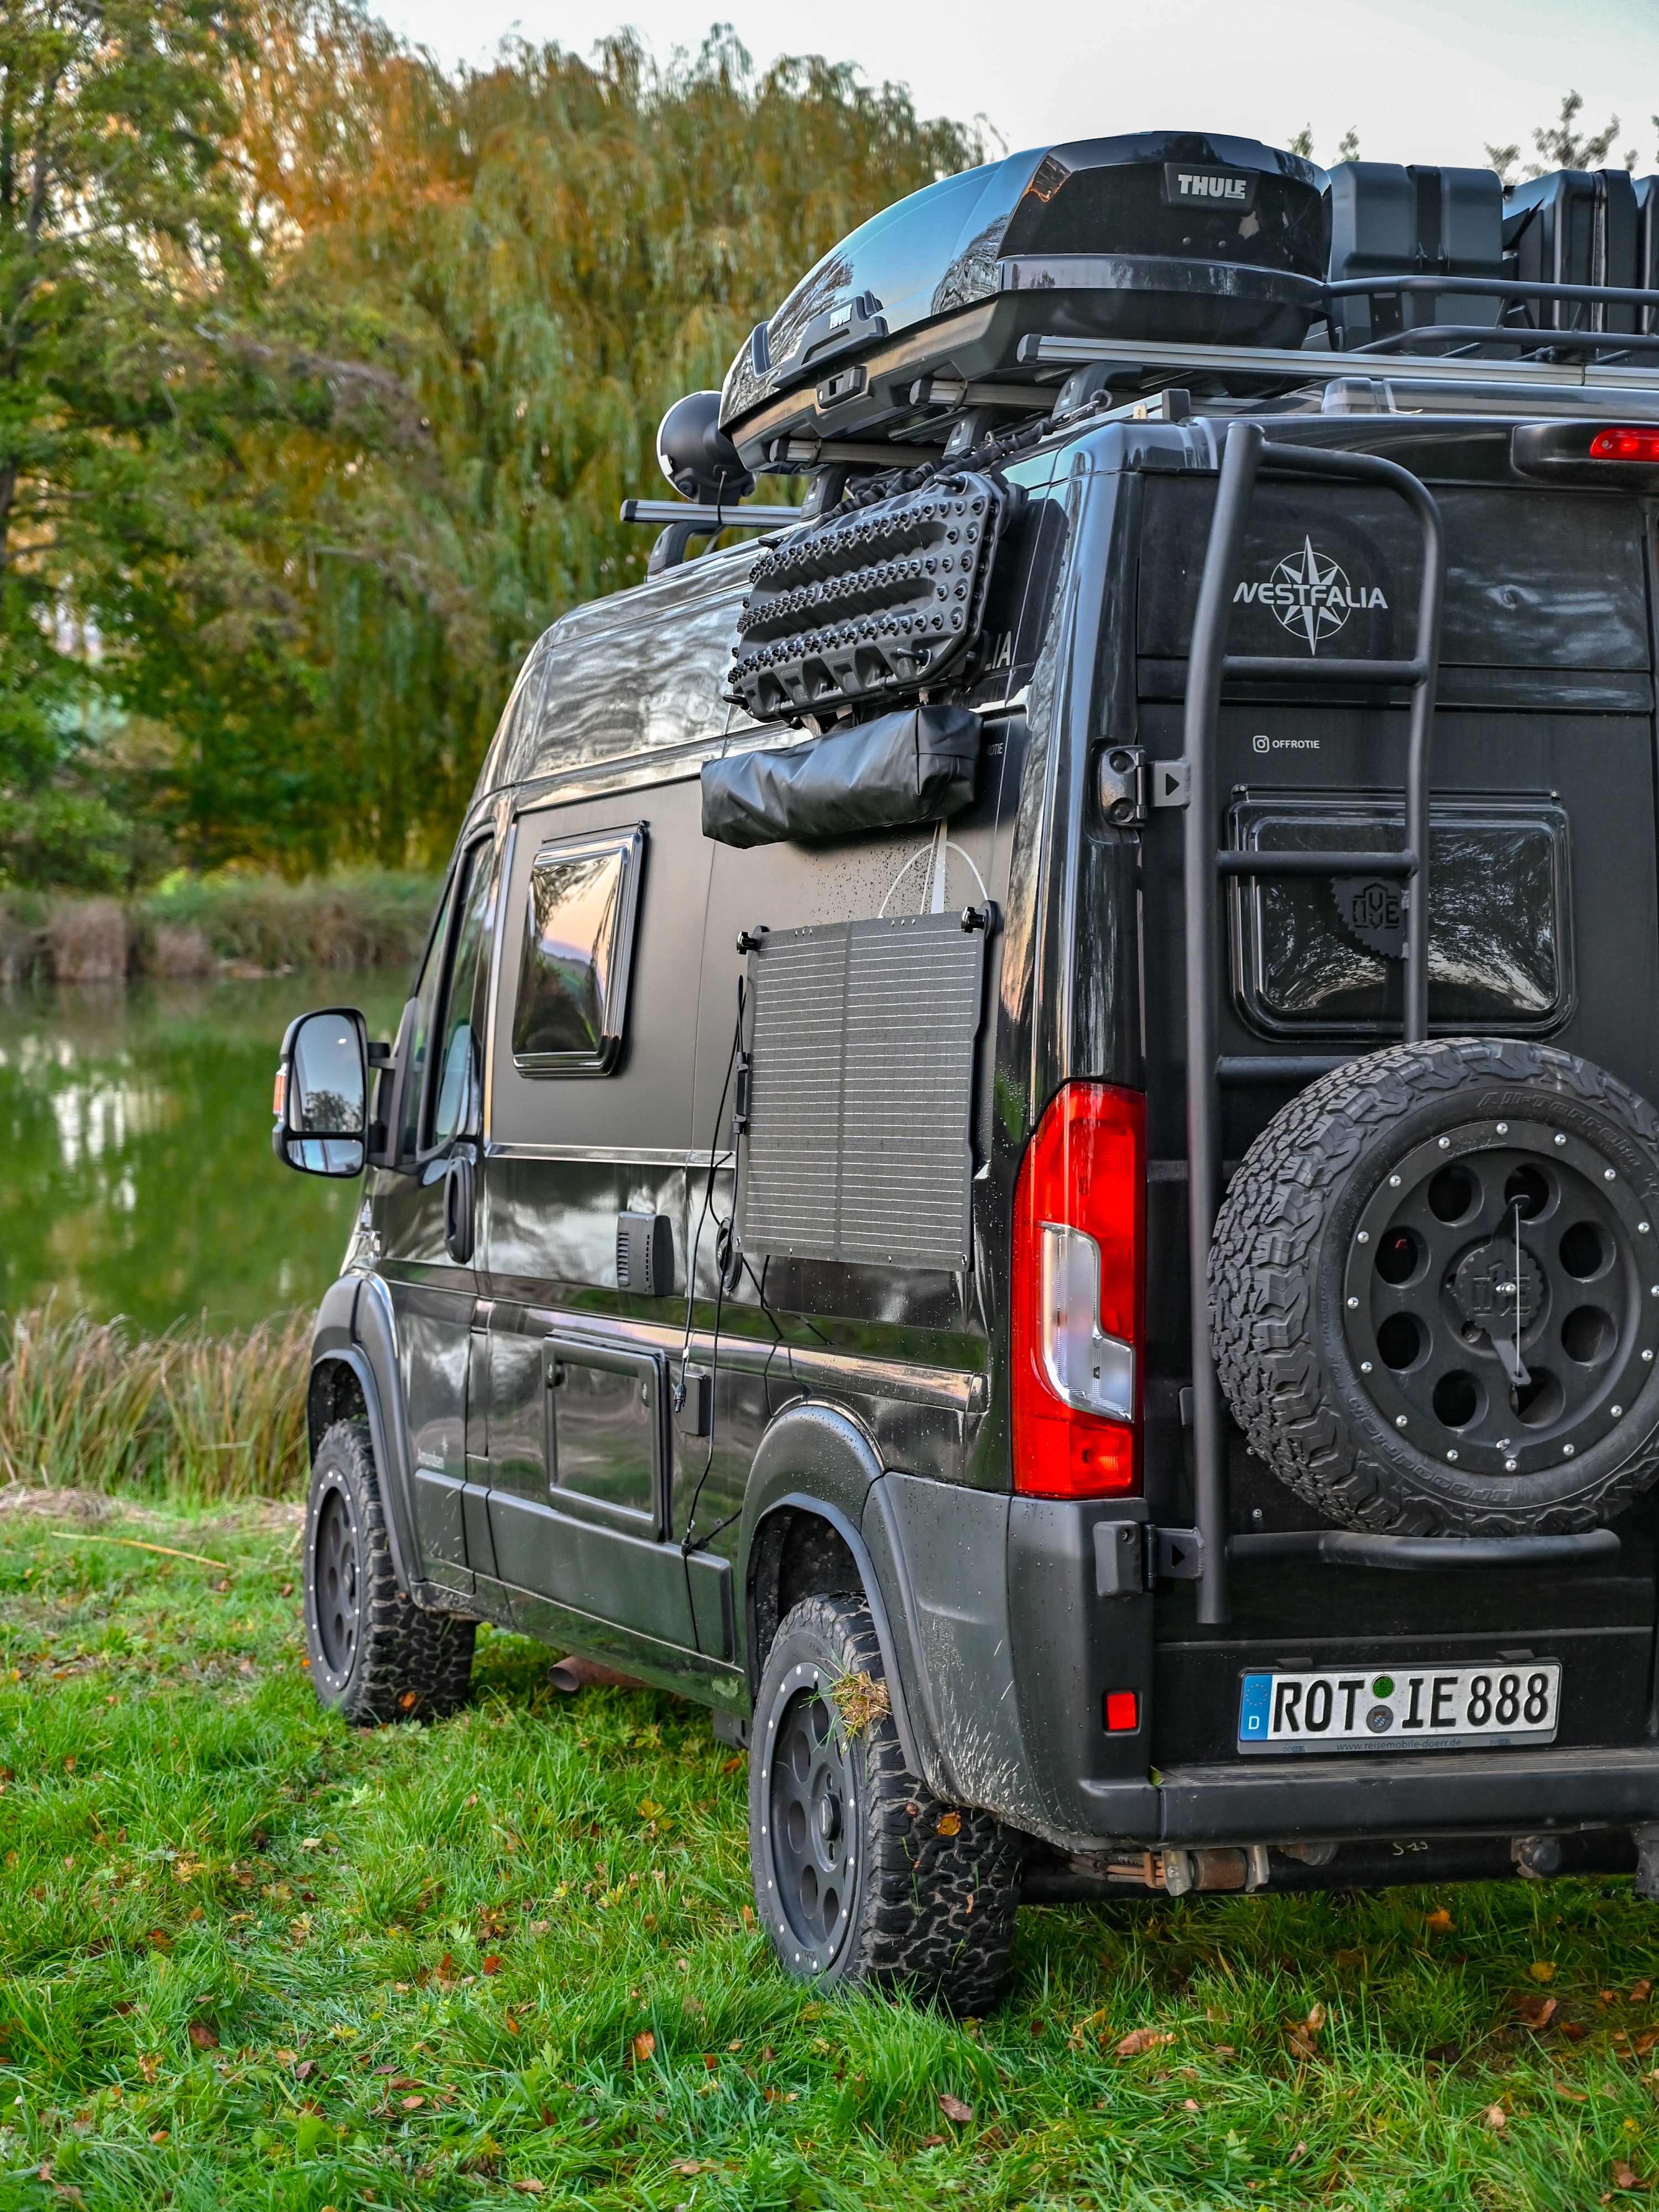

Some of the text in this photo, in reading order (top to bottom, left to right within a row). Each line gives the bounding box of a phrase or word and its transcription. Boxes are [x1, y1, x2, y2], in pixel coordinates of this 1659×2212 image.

[1178, 174, 1246, 199] THULE
[1272, 740, 1320, 749] OFFROTIE
[1273, 1679, 1365, 1733] ROT
[1248, 1715, 1260, 1730] D
[1337, 1738, 1462, 1751] www.reisemobile-doerr.de
